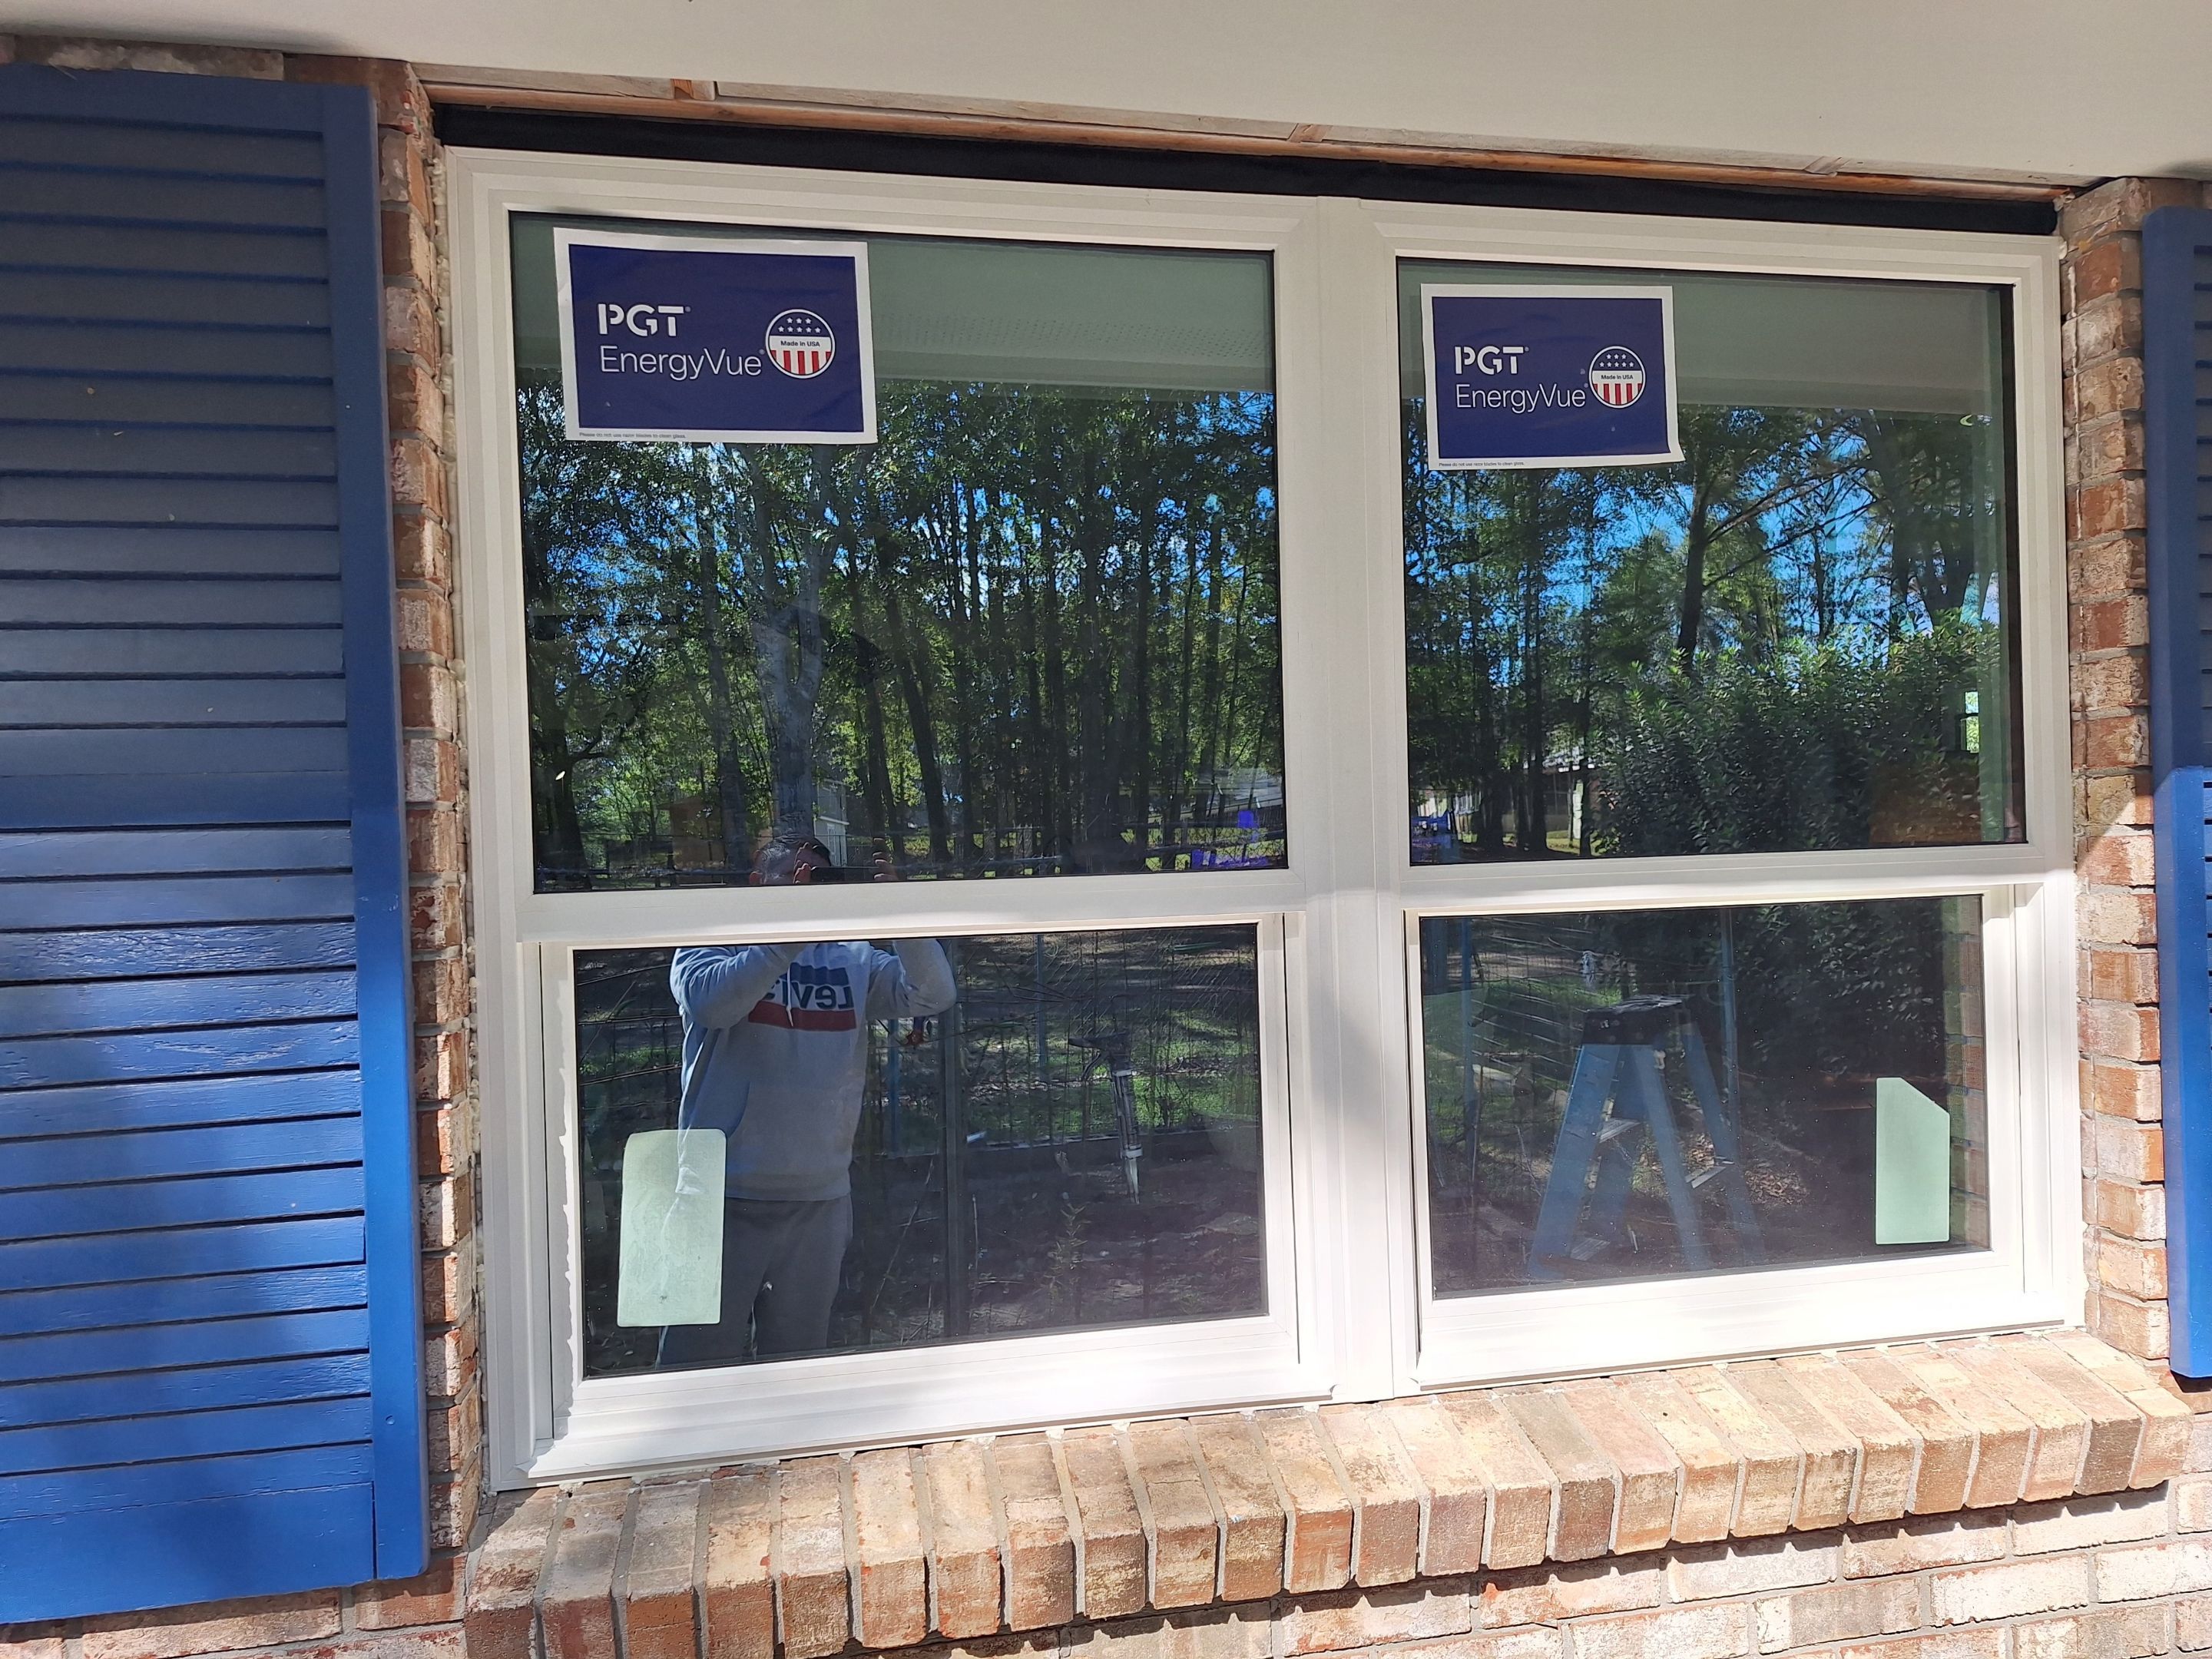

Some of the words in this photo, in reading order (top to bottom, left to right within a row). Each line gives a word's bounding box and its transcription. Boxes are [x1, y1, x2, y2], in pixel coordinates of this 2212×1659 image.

[598, 303, 684, 337] PGT
[601, 345, 761, 381] EnergyVue
[1455, 346, 1524, 375] PGT
[1456, 383, 1586, 414] EnergyVue
